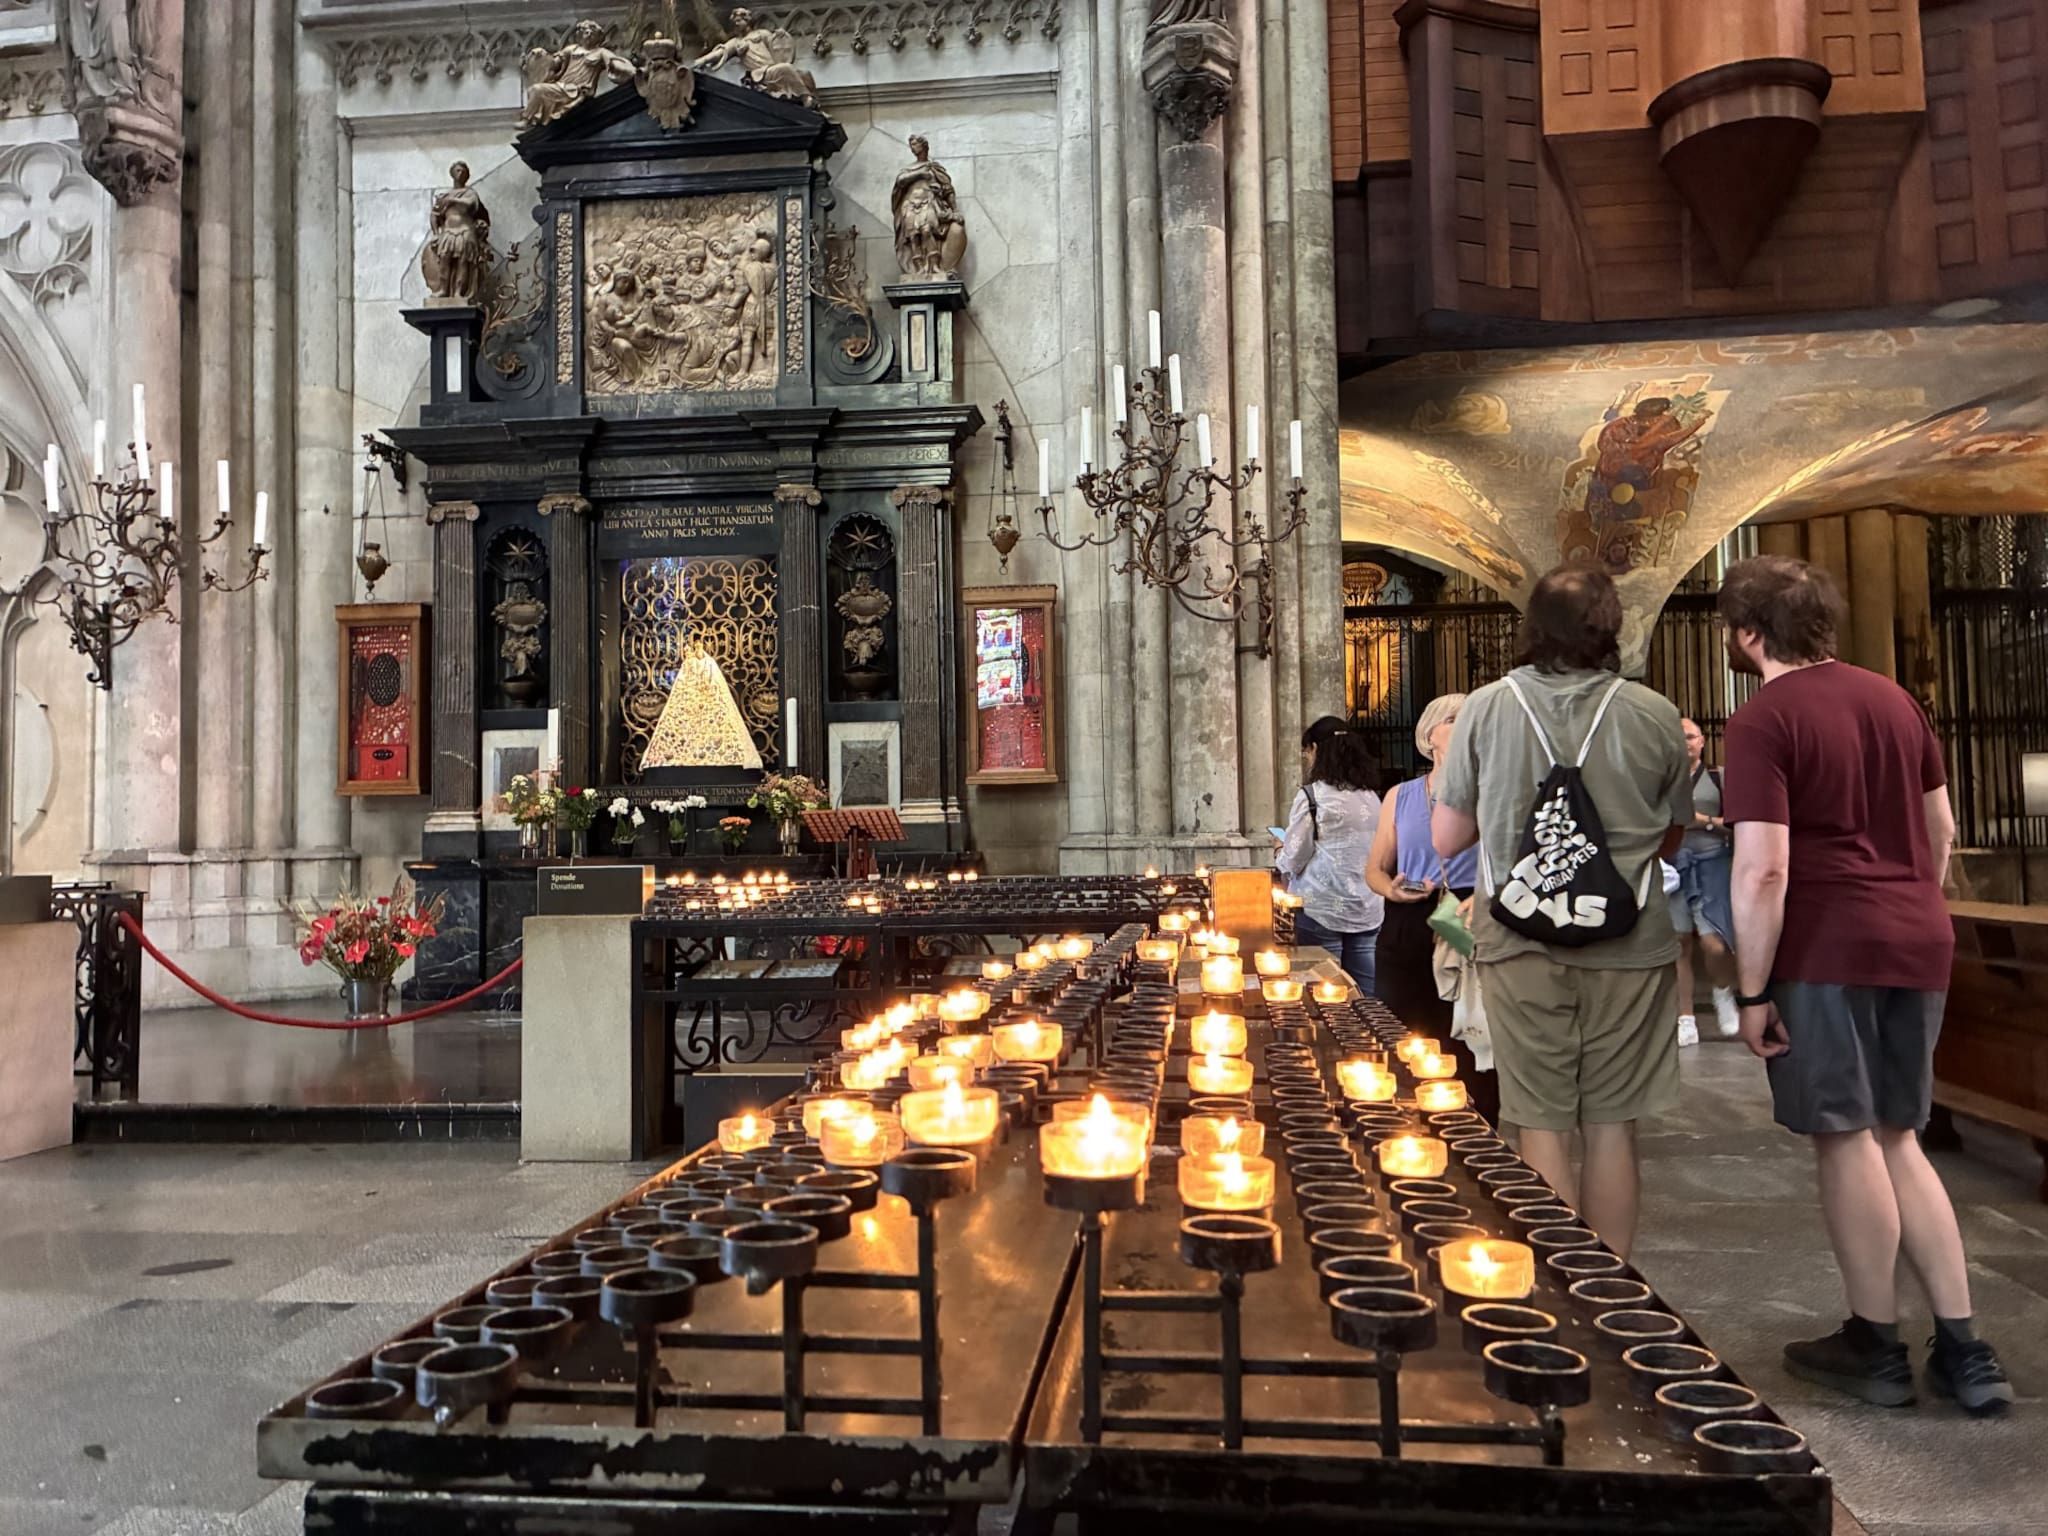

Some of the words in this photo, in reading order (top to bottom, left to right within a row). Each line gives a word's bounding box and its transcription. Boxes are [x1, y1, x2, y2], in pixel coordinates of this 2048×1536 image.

[735, 504, 774, 514] VIRGINIS
[655, 517, 688, 527] STABAT
[712, 515, 774, 526] TRANSLATUM
[641, 529, 668, 538] ANNO
[673, 528, 697, 538] PACIS
[551, 873, 576, 882] Spende
